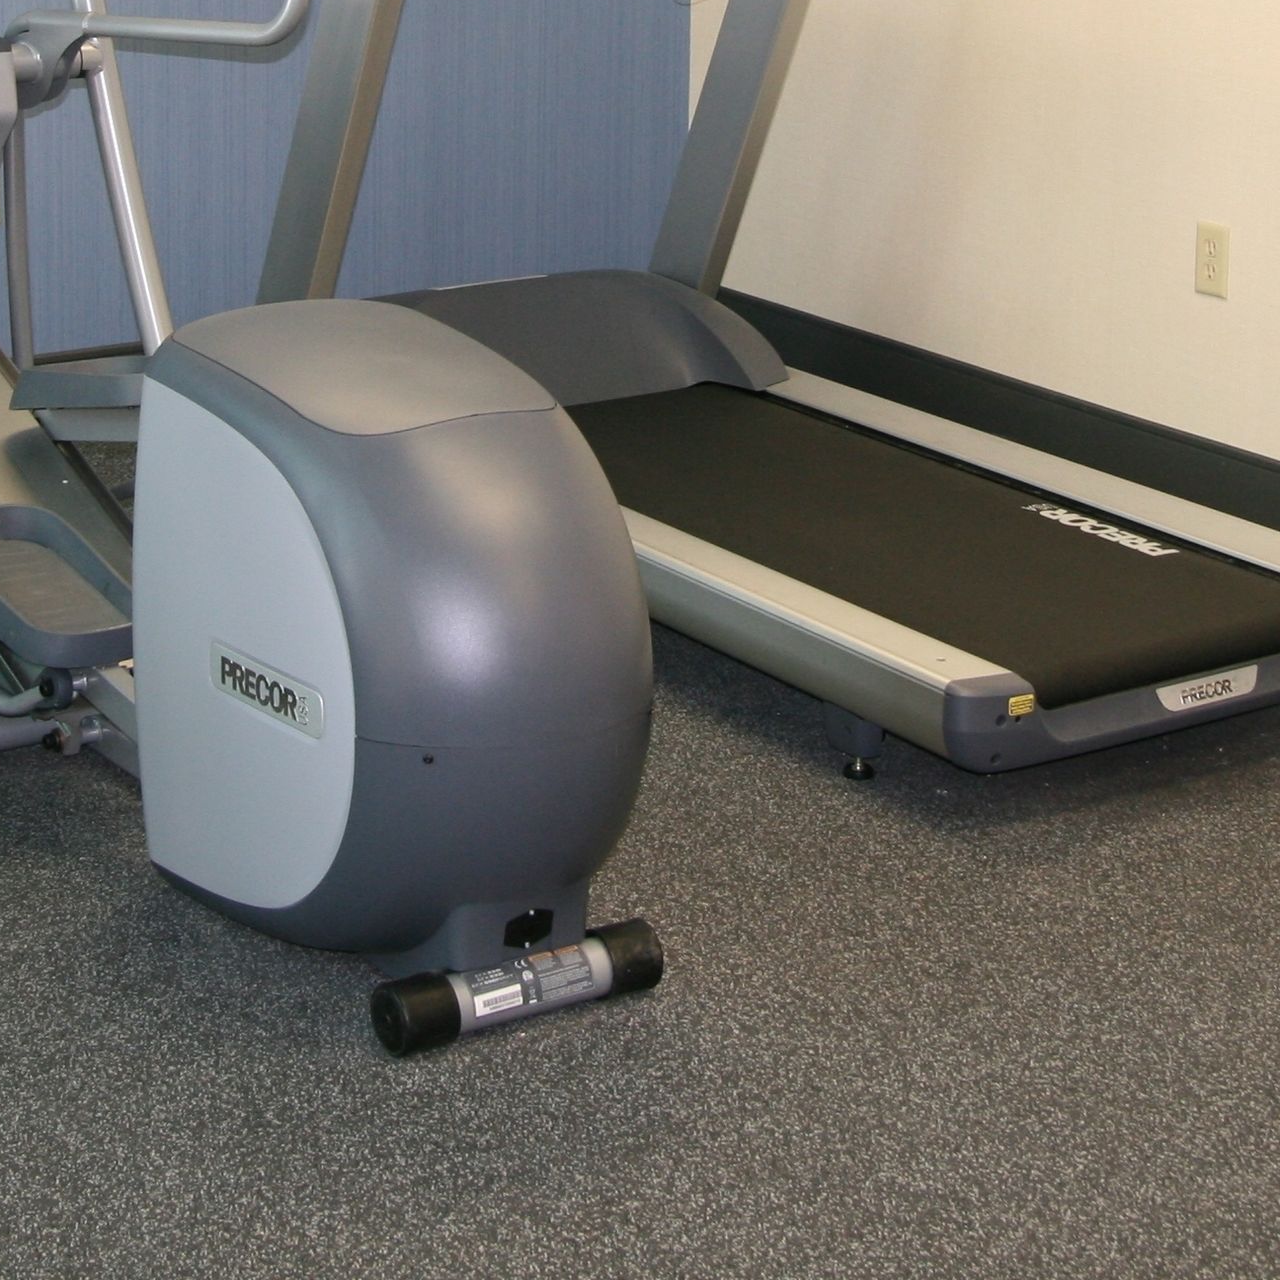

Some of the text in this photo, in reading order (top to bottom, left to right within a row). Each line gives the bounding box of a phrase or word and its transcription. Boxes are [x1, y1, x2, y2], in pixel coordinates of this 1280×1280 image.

[1038, 508, 1180, 556] PRECOR
[220, 655, 298, 722] PRECOR
[1180, 678, 1233, 705] PRECOR
